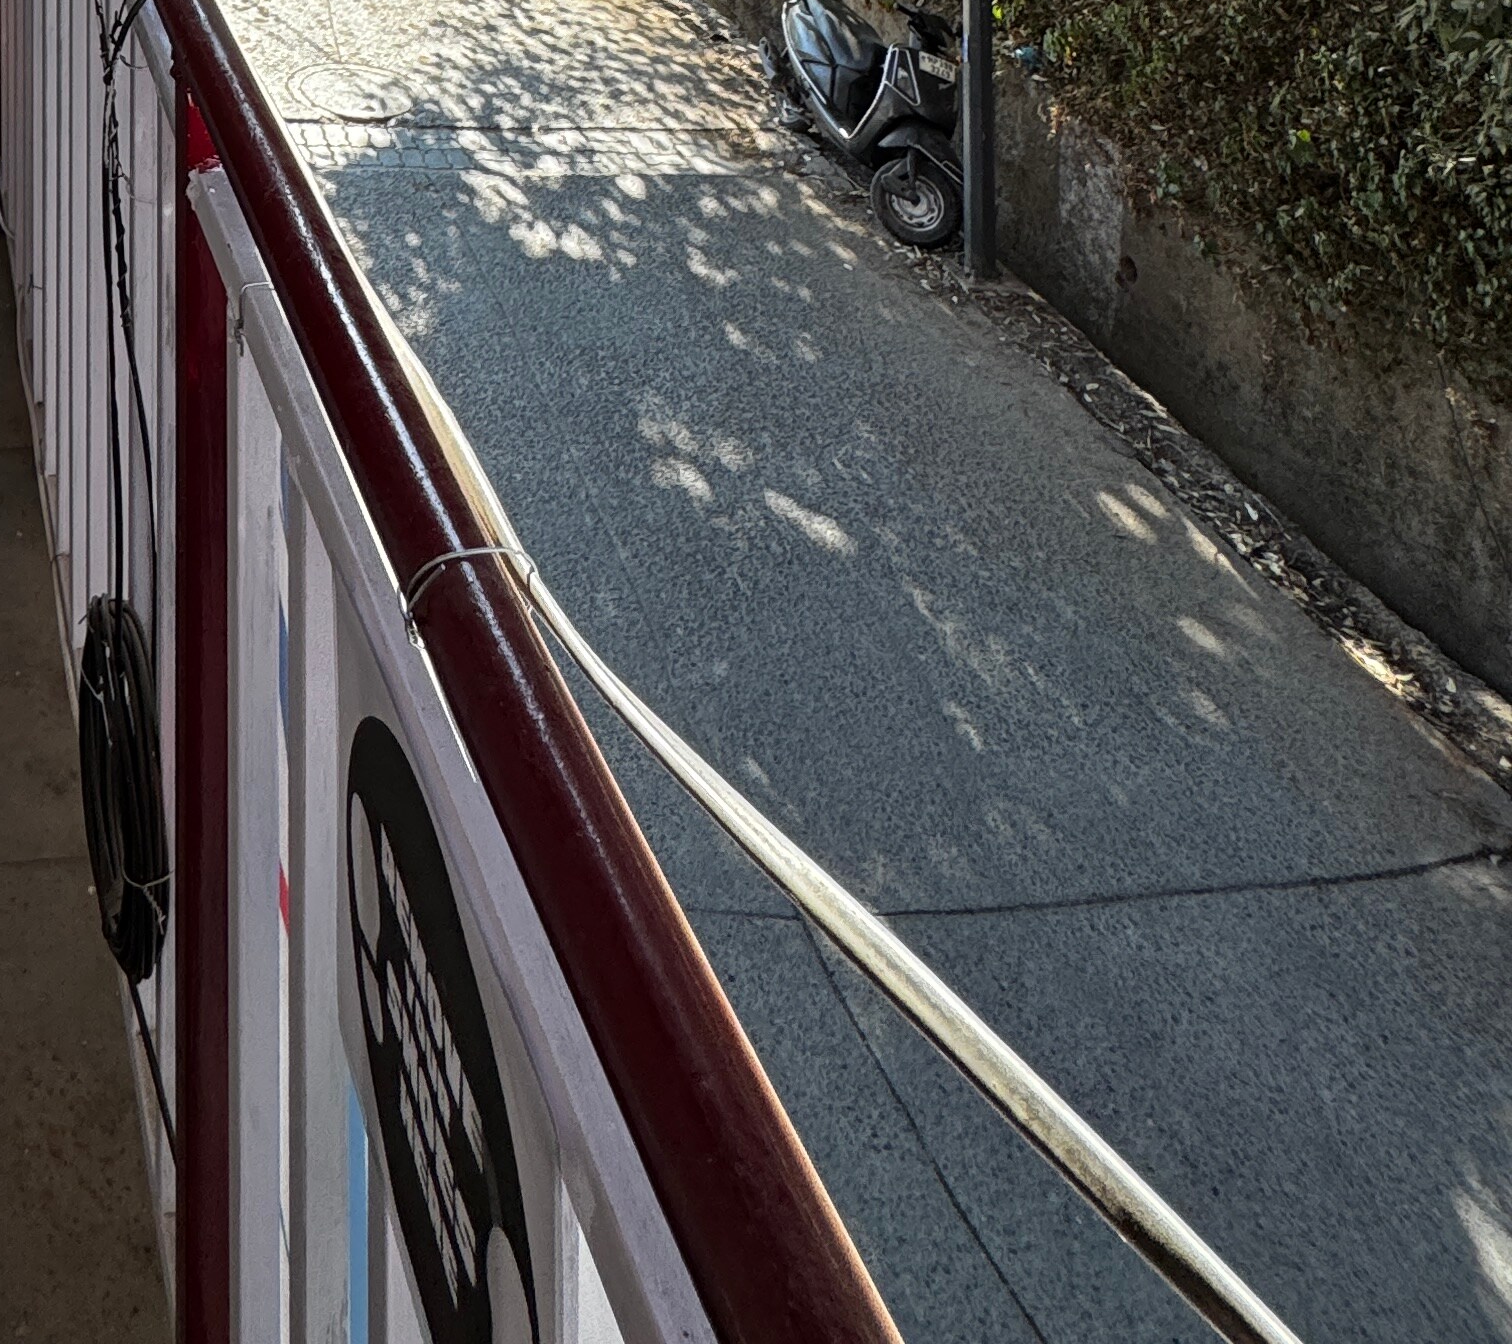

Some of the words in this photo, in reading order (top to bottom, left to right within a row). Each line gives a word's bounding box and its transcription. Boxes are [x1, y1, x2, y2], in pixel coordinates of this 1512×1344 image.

[381, 823, 483, 1173] REMOVE
[387, 960, 476, 1294] SHOES
[405, 962, 450, 1138] YOUR
[400, 1070, 457, 1309] HERE
